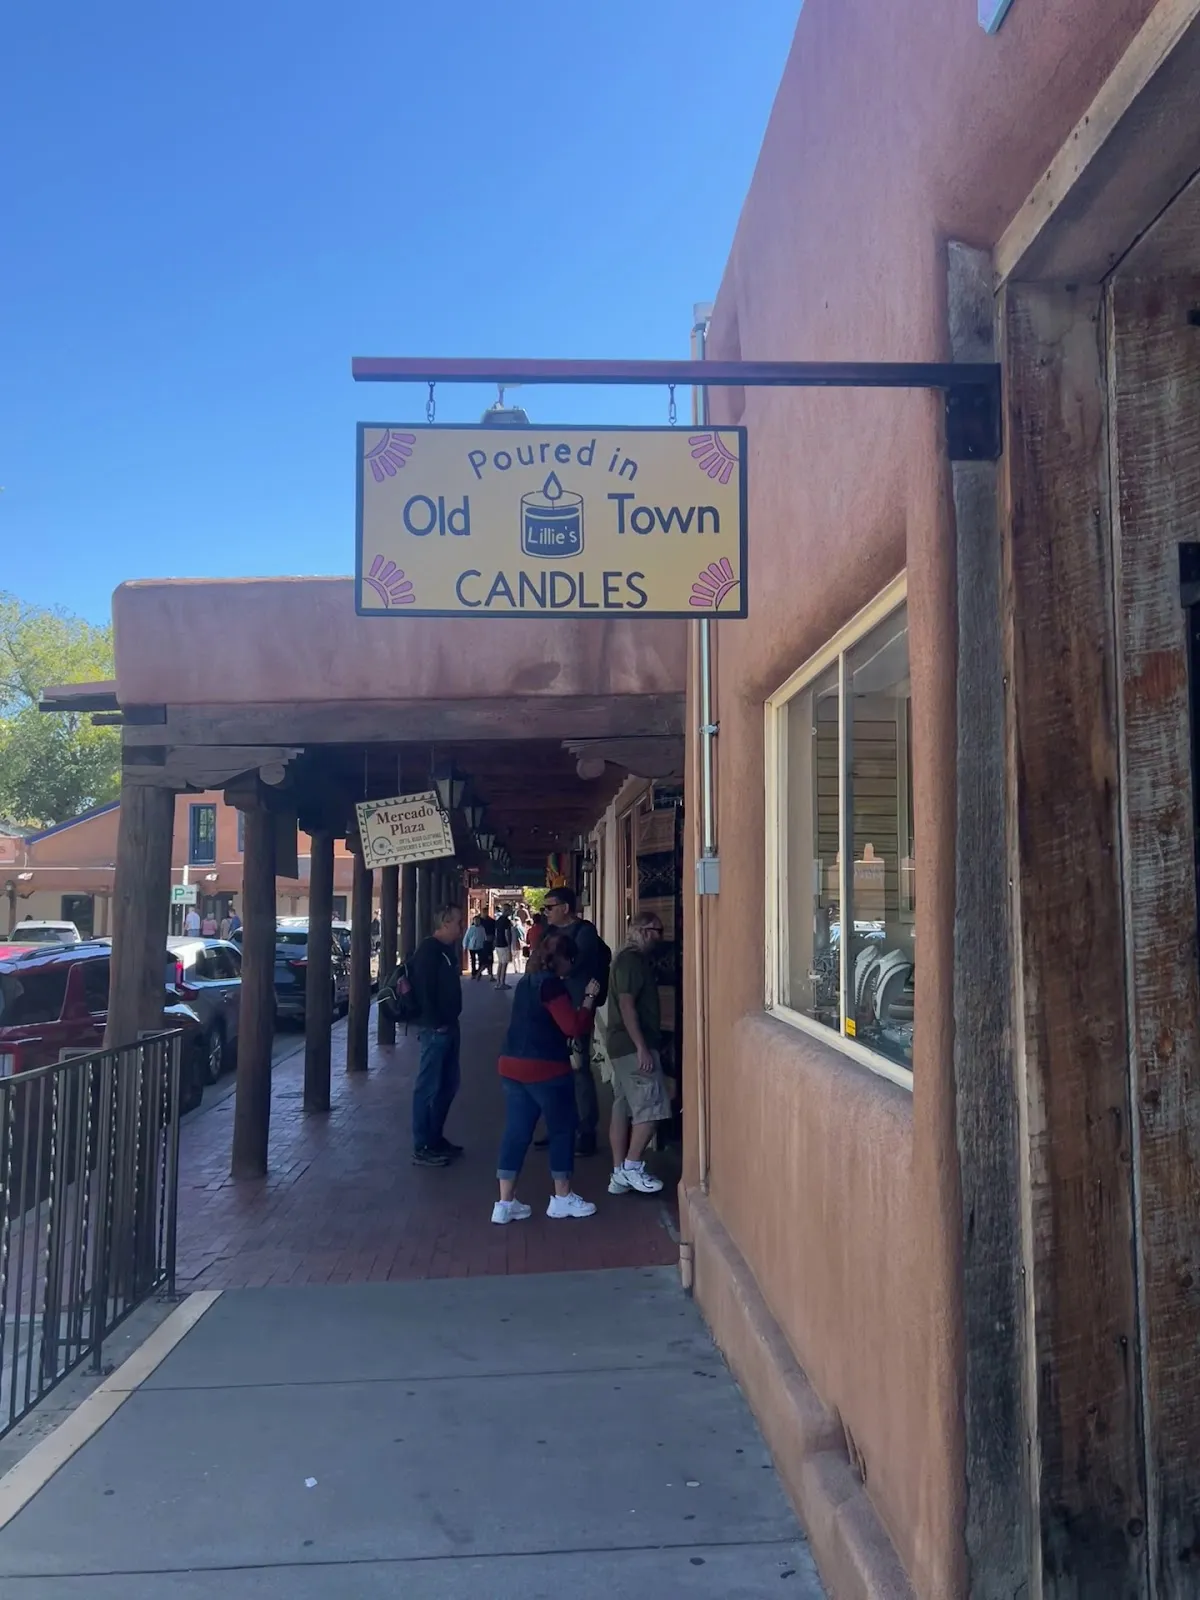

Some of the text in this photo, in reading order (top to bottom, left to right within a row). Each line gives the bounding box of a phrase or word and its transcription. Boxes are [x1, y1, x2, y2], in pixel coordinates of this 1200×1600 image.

[467, 438, 639, 481] Poured in
[403, 493, 720, 536] Old Town
[527, 526, 577, 545] Lillie's
[455, 569, 648, 609] CANDLES
[377, 806, 434, 825] Mercado
[390, 823, 425, 836] Plaza
[174, 888, 185, 901] P
